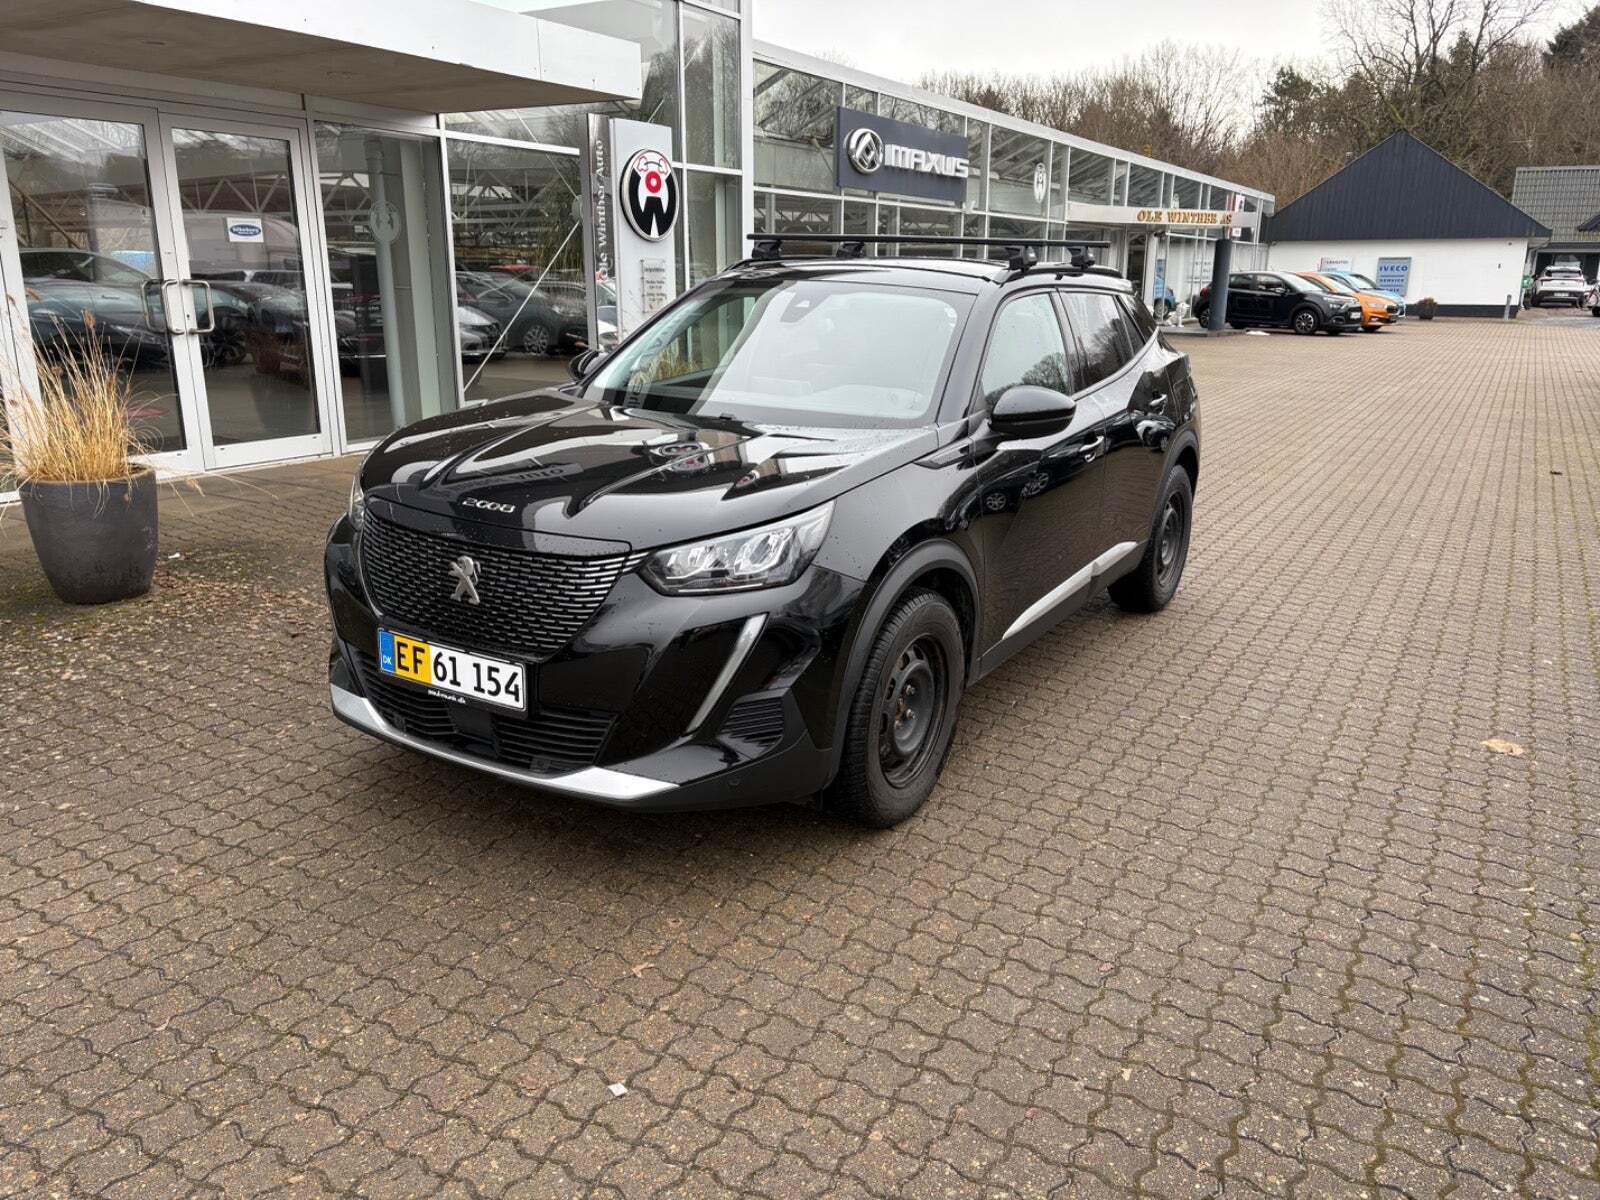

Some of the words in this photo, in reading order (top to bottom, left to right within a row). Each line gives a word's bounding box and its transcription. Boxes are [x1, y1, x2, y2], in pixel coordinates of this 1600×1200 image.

[595, 139, 605, 178] Auto
[885, 143, 970, 178] MAXUS
[597, 185, 607, 248] Winther
[1137, 210, 1163, 222] OLE
[1167, 211, 1217, 225] WINTHER
[598, 252, 608, 281] Ole
[1379, 264, 1408, 272] IVECO
[462, 497, 516, 514] 2008
[382, 655, 392, 665] DK
[396, 641, 425, 675] EF
[433, 651, 461, 687] 61
[473, 662, 520, 703] 154
